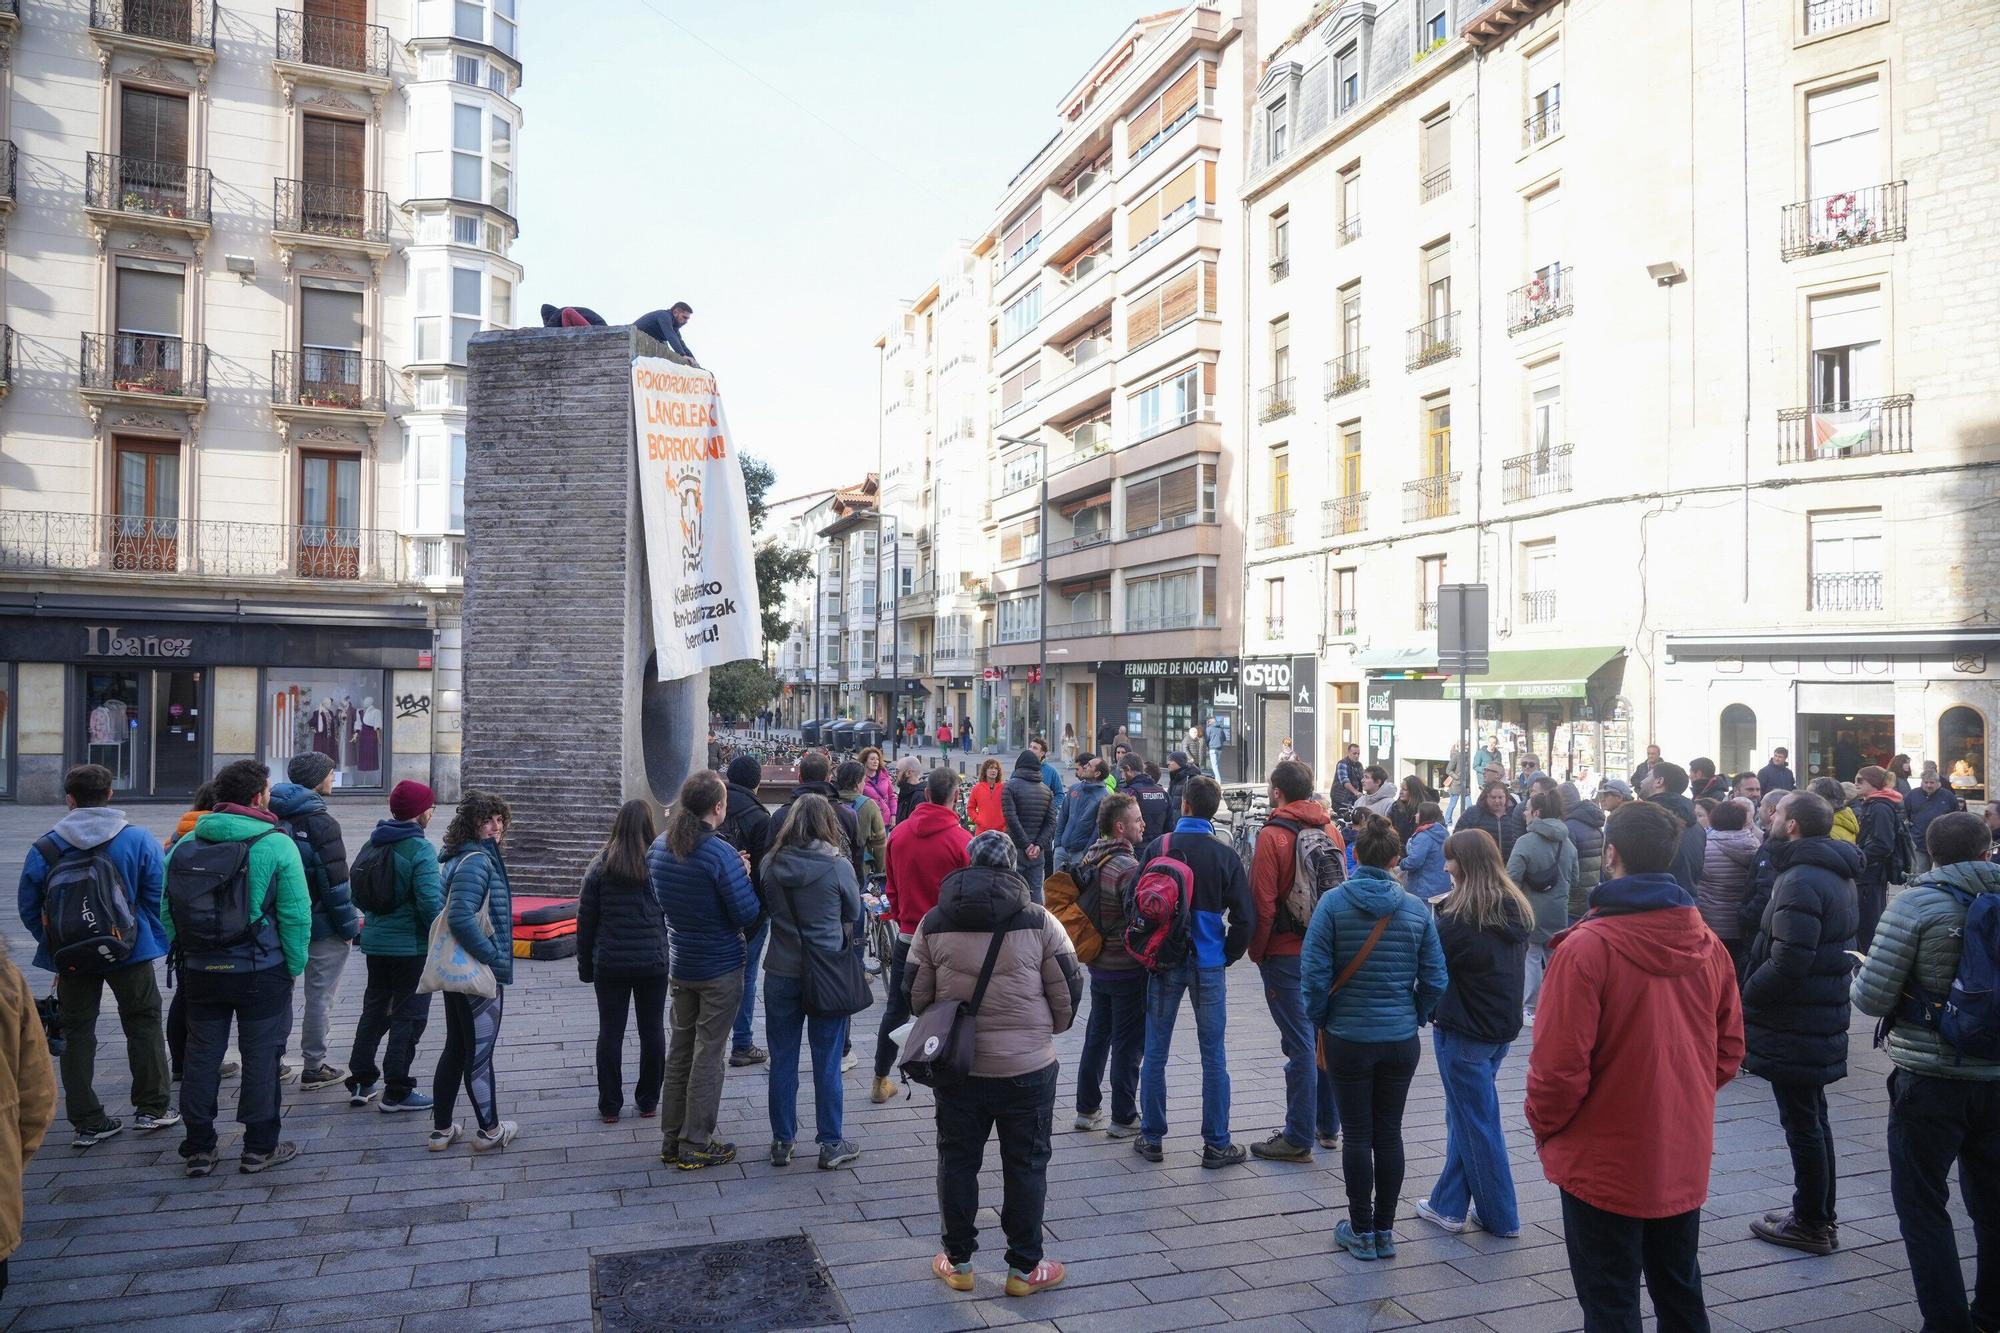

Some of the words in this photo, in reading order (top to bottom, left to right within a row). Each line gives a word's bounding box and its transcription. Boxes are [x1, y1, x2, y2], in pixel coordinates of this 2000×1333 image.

[84, 626, 193, 657] Ibañez
[1124, 662, 1167, 675] FERNANDEZ
[1169, 661, 1181, 675] DE
[1182, 660, 1228, 675] NOGRARO
